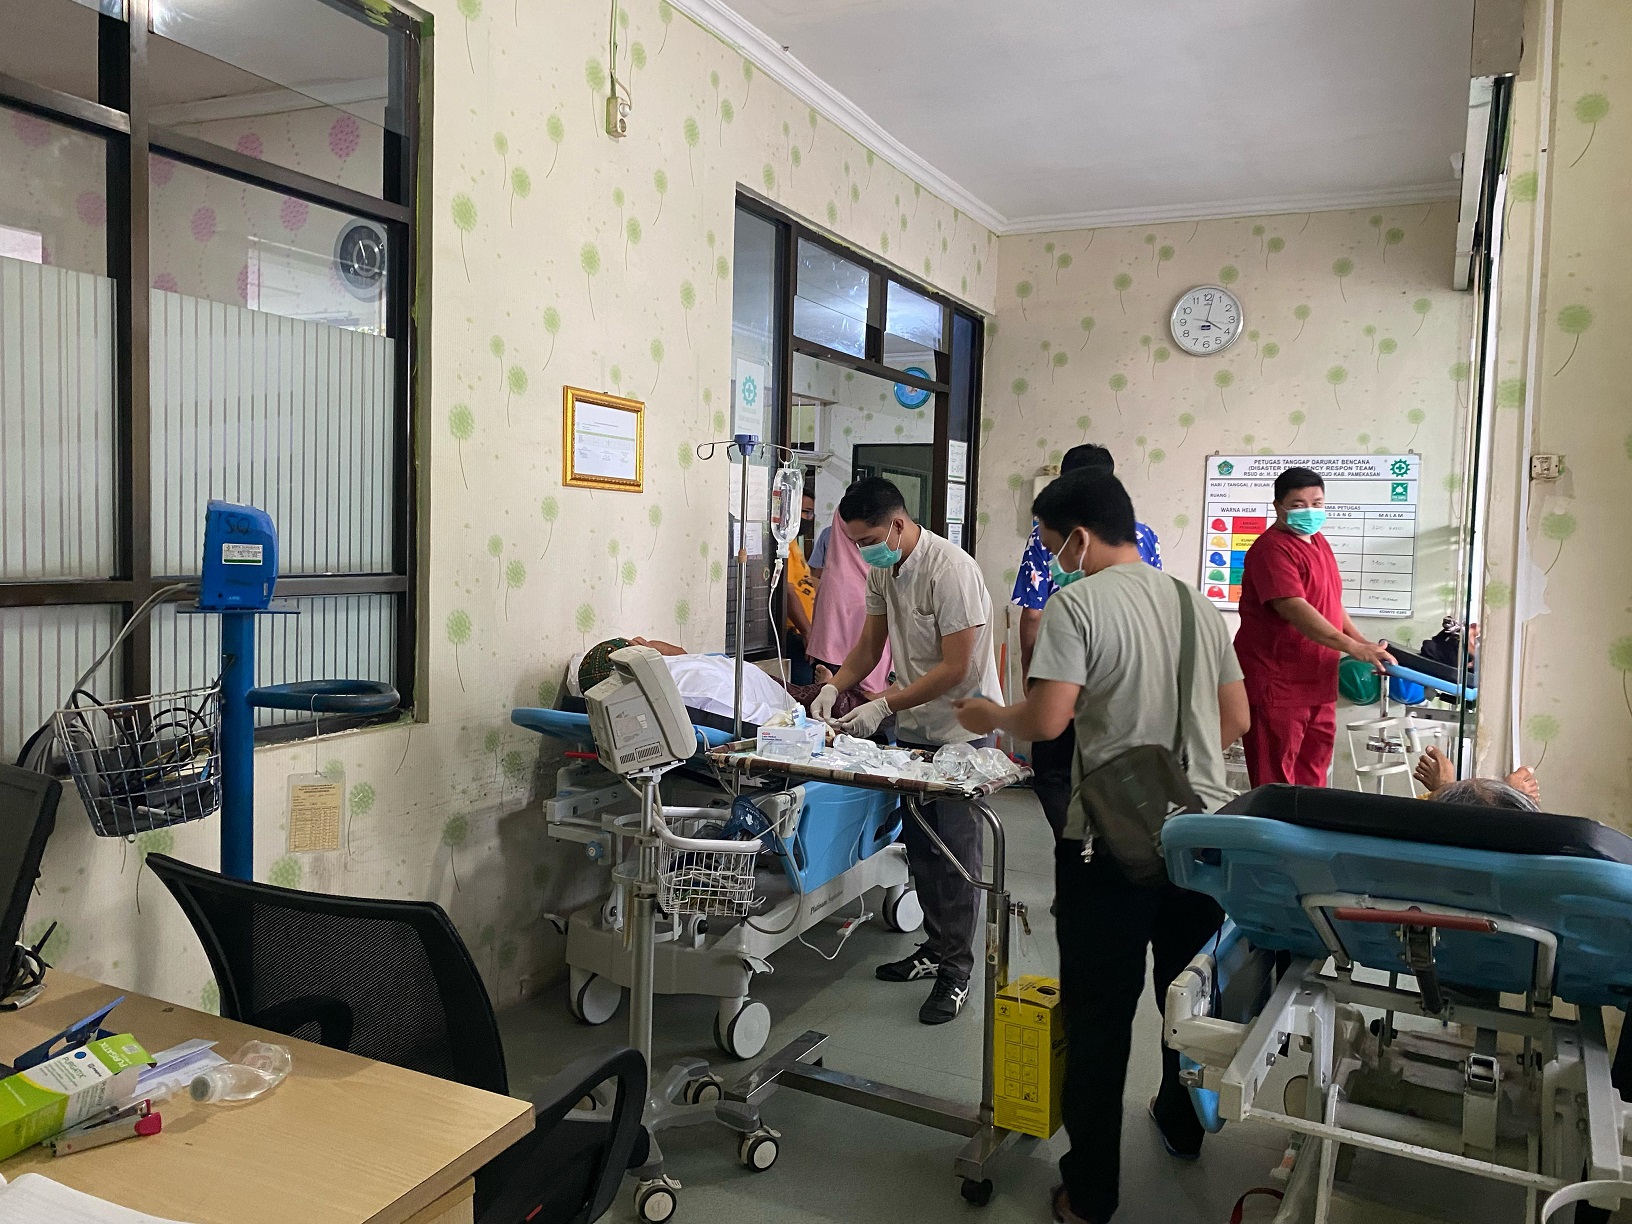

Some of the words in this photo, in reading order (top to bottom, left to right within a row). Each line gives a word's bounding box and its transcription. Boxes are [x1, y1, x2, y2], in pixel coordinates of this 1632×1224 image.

[1203, 293, 1212, 301] 12
[1183, 307, 1192, 315] 10
[1225, 304, 1232, 312] 2
[1180, 318, 1186, 326] 9
[1228, 316, 1235, 324] 3
[1192, 338, 1199, 346] 7
[1203, 341, 1210, 349] 6
[1215, 337, 1221, 345] 5
